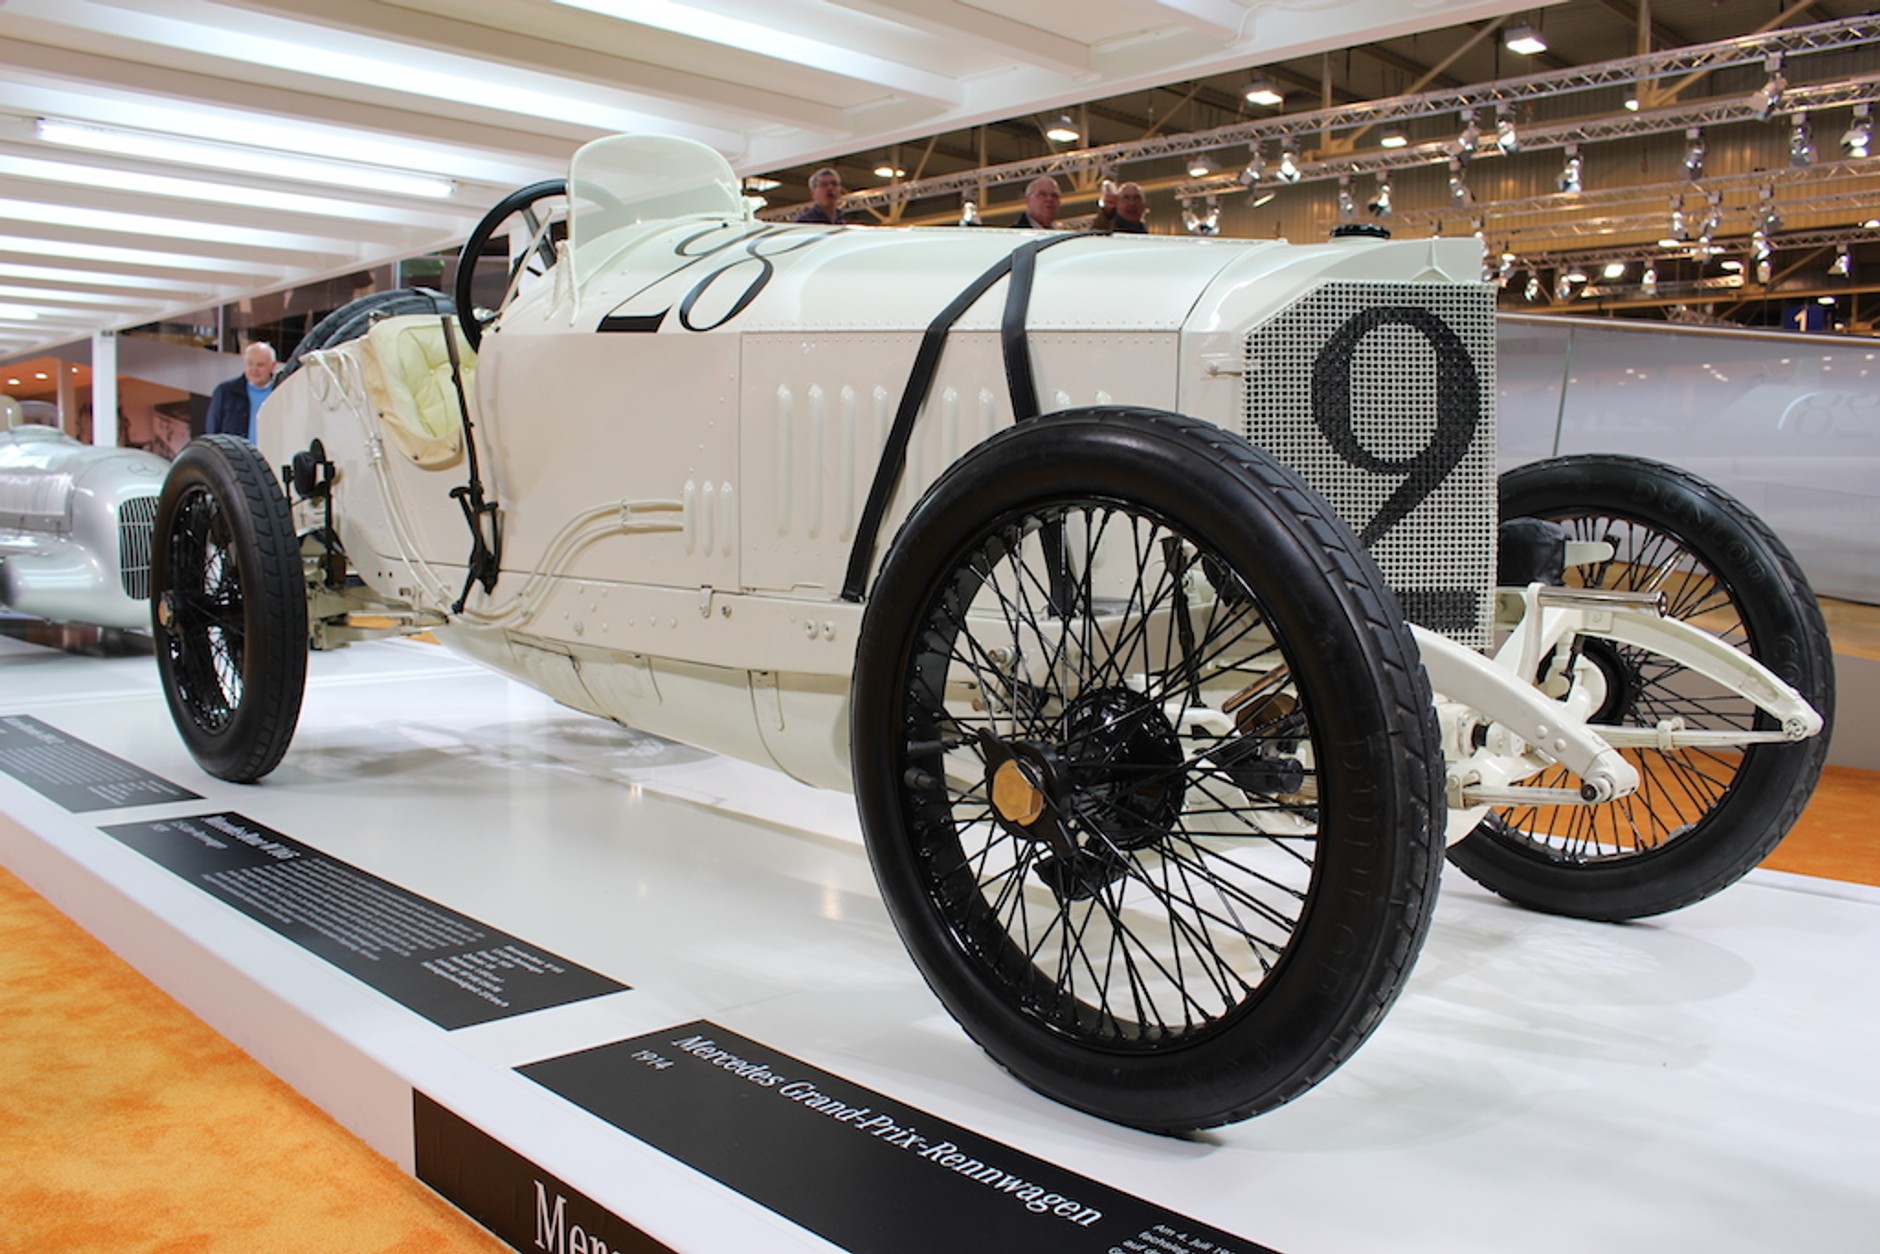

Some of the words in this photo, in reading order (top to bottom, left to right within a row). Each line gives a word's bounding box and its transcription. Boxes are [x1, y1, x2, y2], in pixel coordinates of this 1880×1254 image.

[596, 223, 850, 333] 28
[1794, 309, 1808, 332] 1
[1633, 477, 1767, 586] DUNLOP
[630, 1049, 675, 1071] 1914
[670, 1035, 785, 1087] Mercedes
[779, 1081, 1103, 1227] Grand-Prix-Rennwagen
